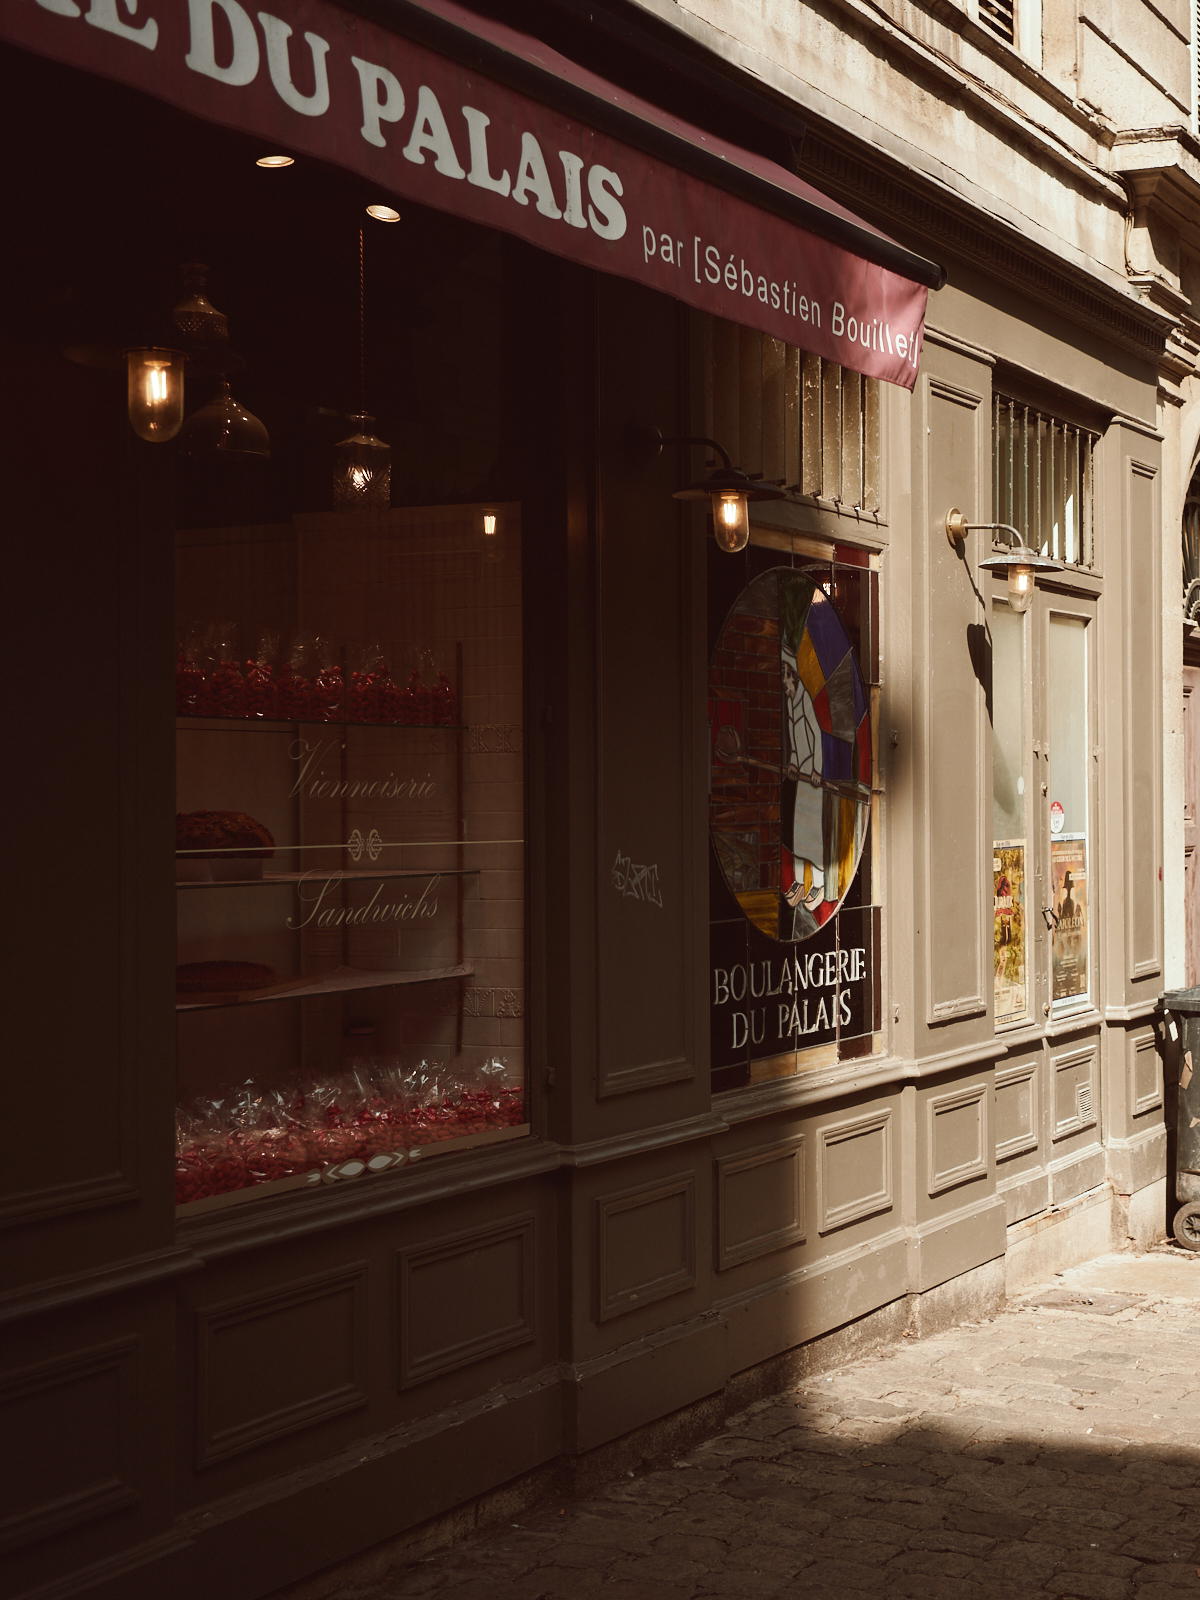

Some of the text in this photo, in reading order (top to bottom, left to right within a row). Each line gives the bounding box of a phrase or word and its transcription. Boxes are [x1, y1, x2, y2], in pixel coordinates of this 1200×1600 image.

[185, 0, 330, 117] DU
[351, 55, 627, 241] PALAIS
[642, 225, 684, 268] par
[694, 236, 821, 328] [Sébastien
[288, 738, 438, 800] Viennoiserie
[286, 867, 440, 930] Sandwichs
[713, 947, 867, 1006] BOULANGERIE
[731, 988, 852, 1049] DU PALAIS
